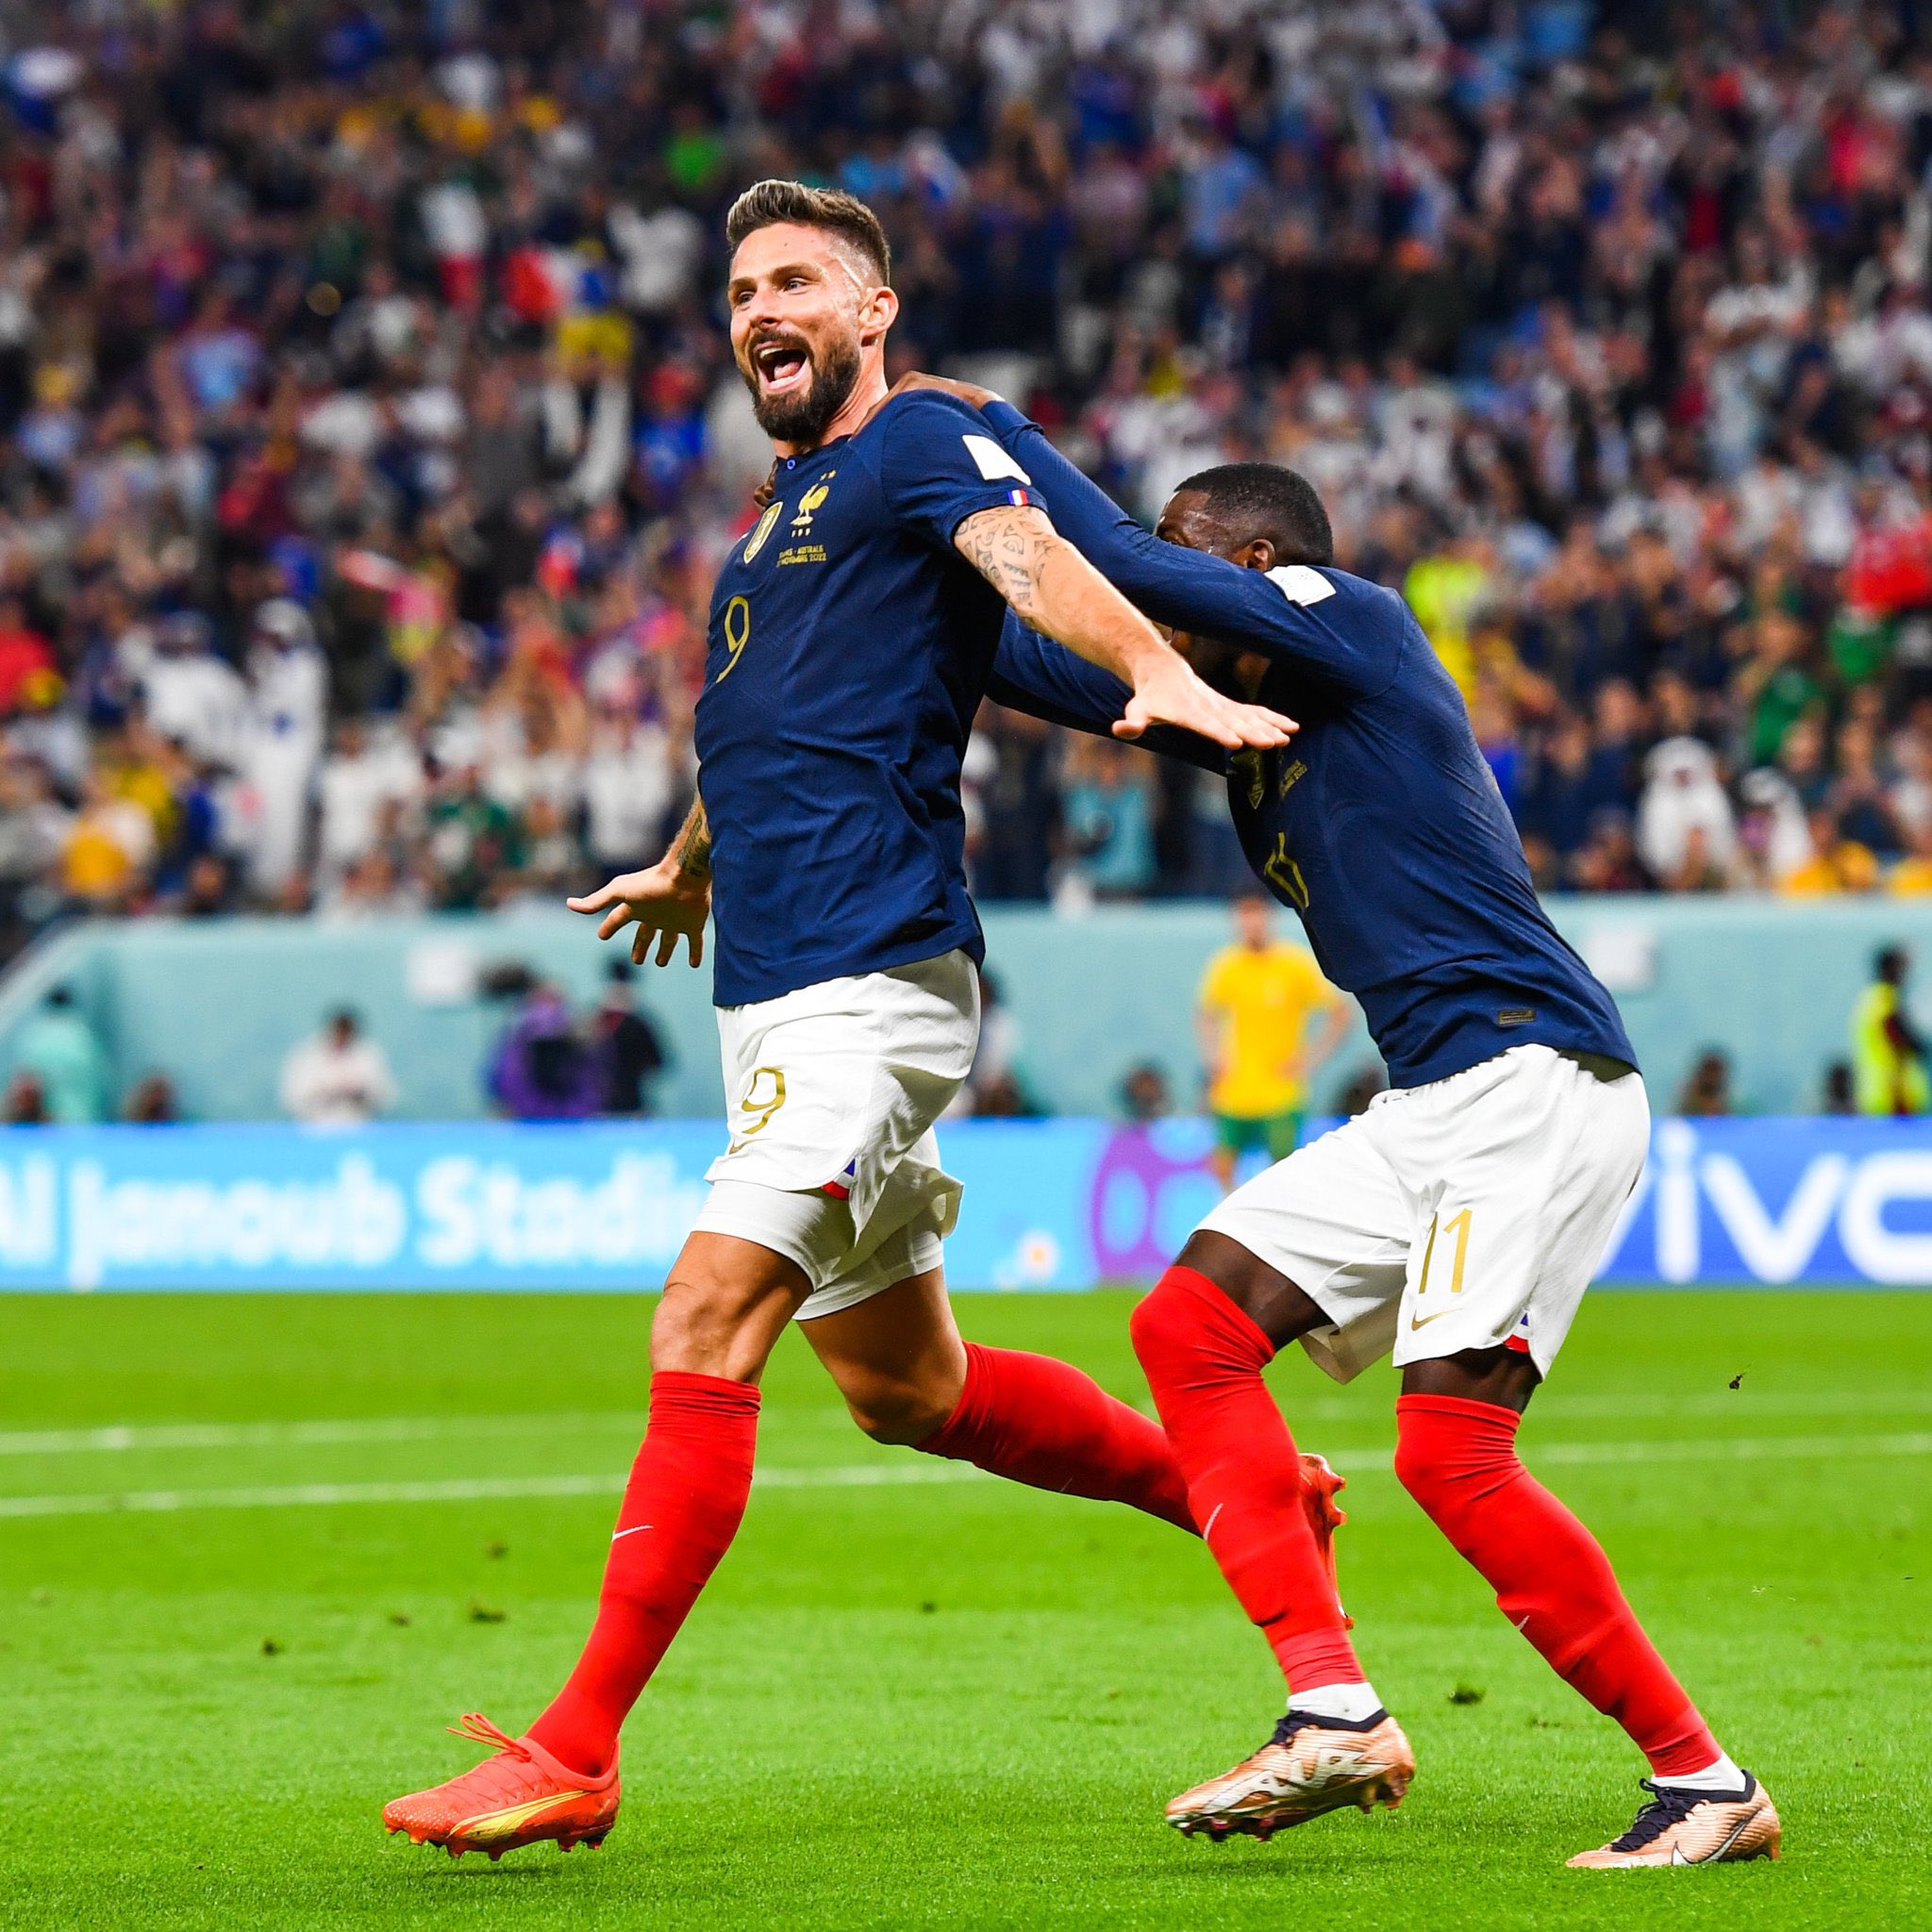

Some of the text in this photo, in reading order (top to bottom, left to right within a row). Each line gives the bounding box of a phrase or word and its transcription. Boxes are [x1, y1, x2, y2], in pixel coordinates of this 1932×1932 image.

[716, 594, 750, 684] 9
[741, 1066, 787, 1135] 9
[416, 1149, 708, 1268] Stadi
[1418, 1208, 1473, 1294] 11
